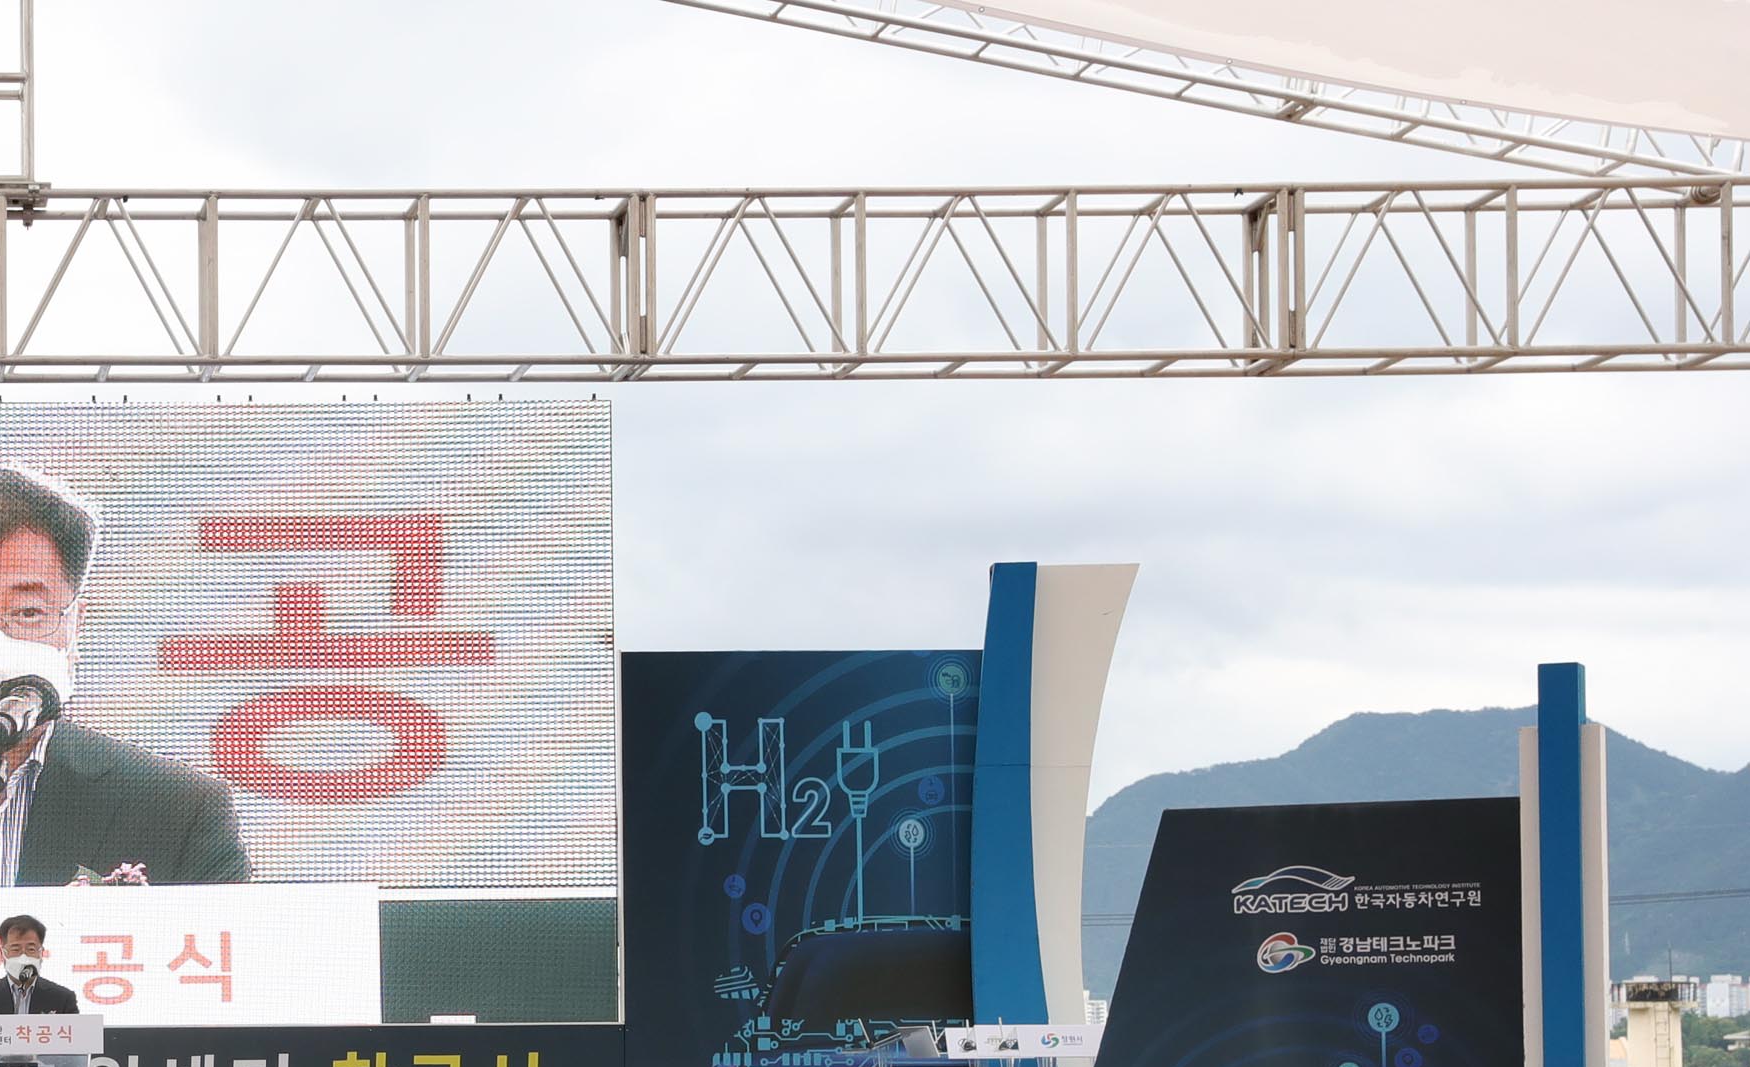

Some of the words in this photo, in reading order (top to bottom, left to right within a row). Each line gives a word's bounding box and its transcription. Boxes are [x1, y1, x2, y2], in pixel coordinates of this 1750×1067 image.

[1235, 893, 1348, 913] KATECH
[1354, 891, 1482, 909] 한국자동차연구원
[1339, 935, 1456, 953] 경남테크노파크
[1320, 955, 1387, 965] Gyeongnam
[1390, 953, 1455, 963] Technopark
[16, 1025, 72, 1043] 착공식
